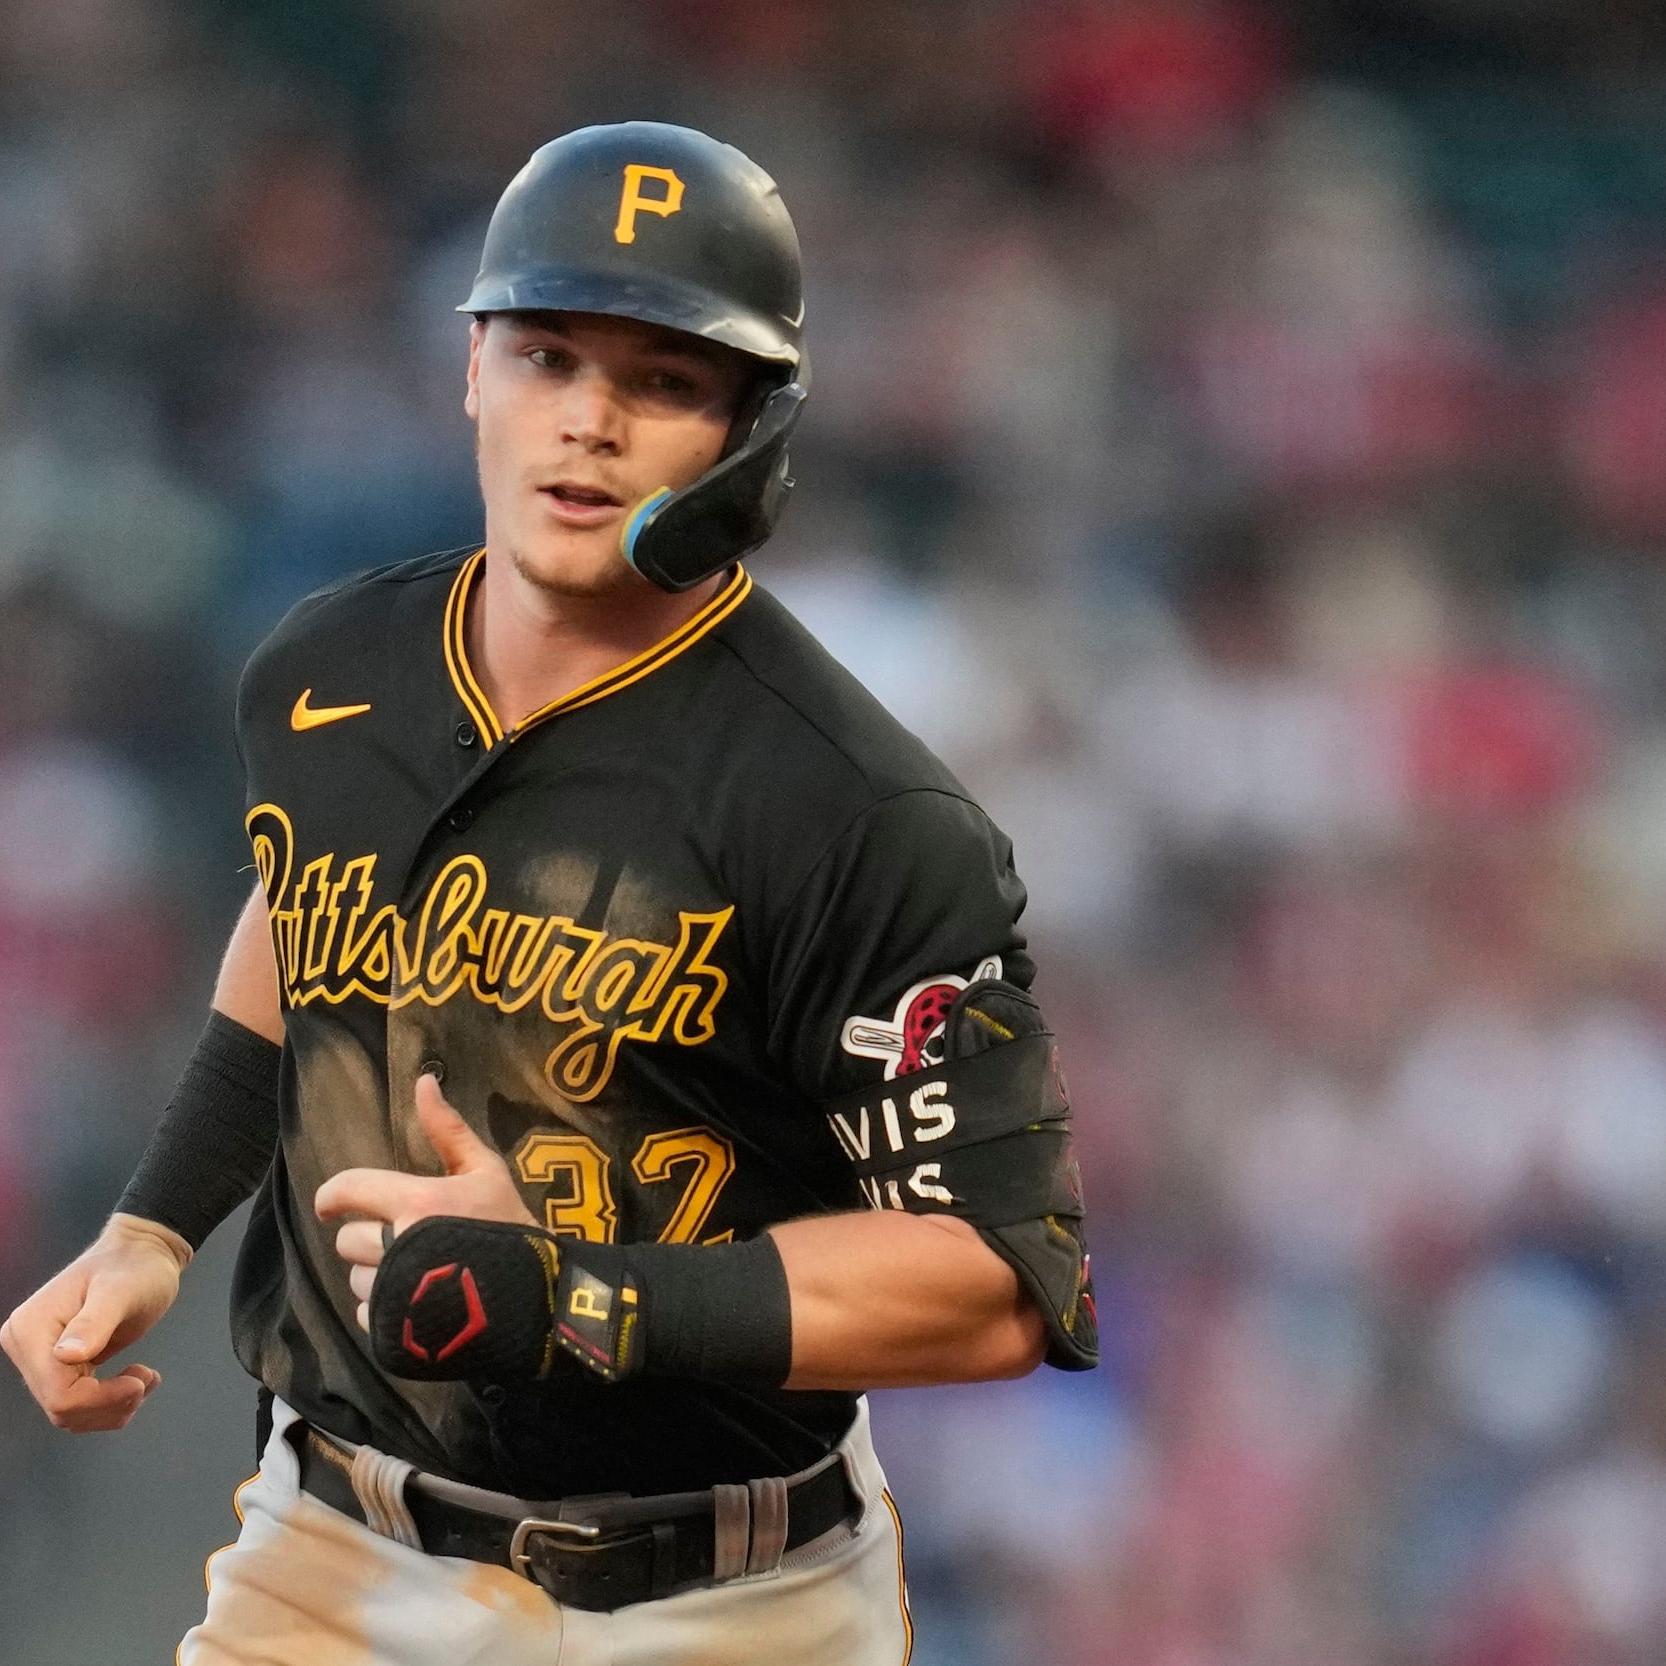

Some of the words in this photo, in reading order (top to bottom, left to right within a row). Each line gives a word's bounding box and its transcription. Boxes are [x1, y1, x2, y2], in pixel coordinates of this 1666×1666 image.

[614, 163, 685, 244] P
[244, 803, 735, 1103] Pittsburgh
[825, 1080, 956, 1162] VIS
[515, 1124, 736, 1246] 32
